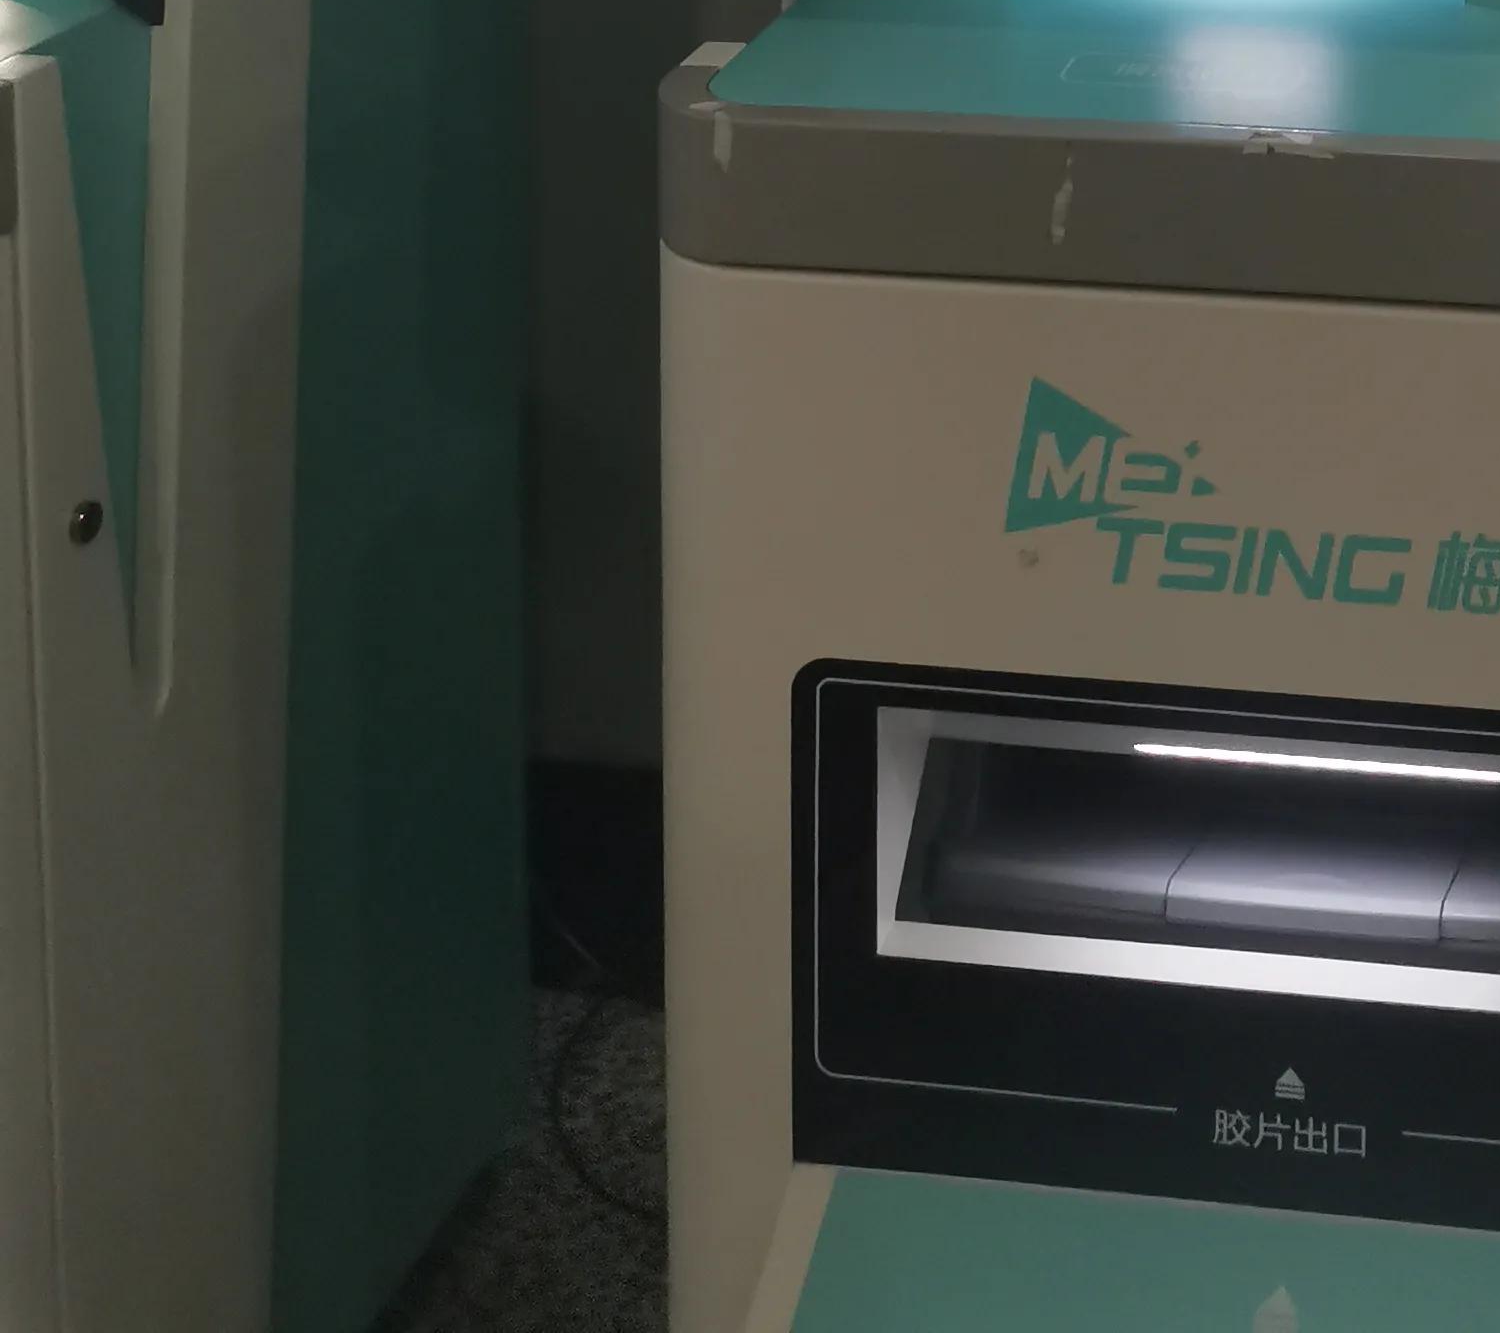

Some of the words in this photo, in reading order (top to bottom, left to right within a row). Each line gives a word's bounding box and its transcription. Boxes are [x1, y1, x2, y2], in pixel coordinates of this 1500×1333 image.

[1096, 516, 1412, 605] TSING
[1212, 1108, 1366, 1159] 胶片出口
